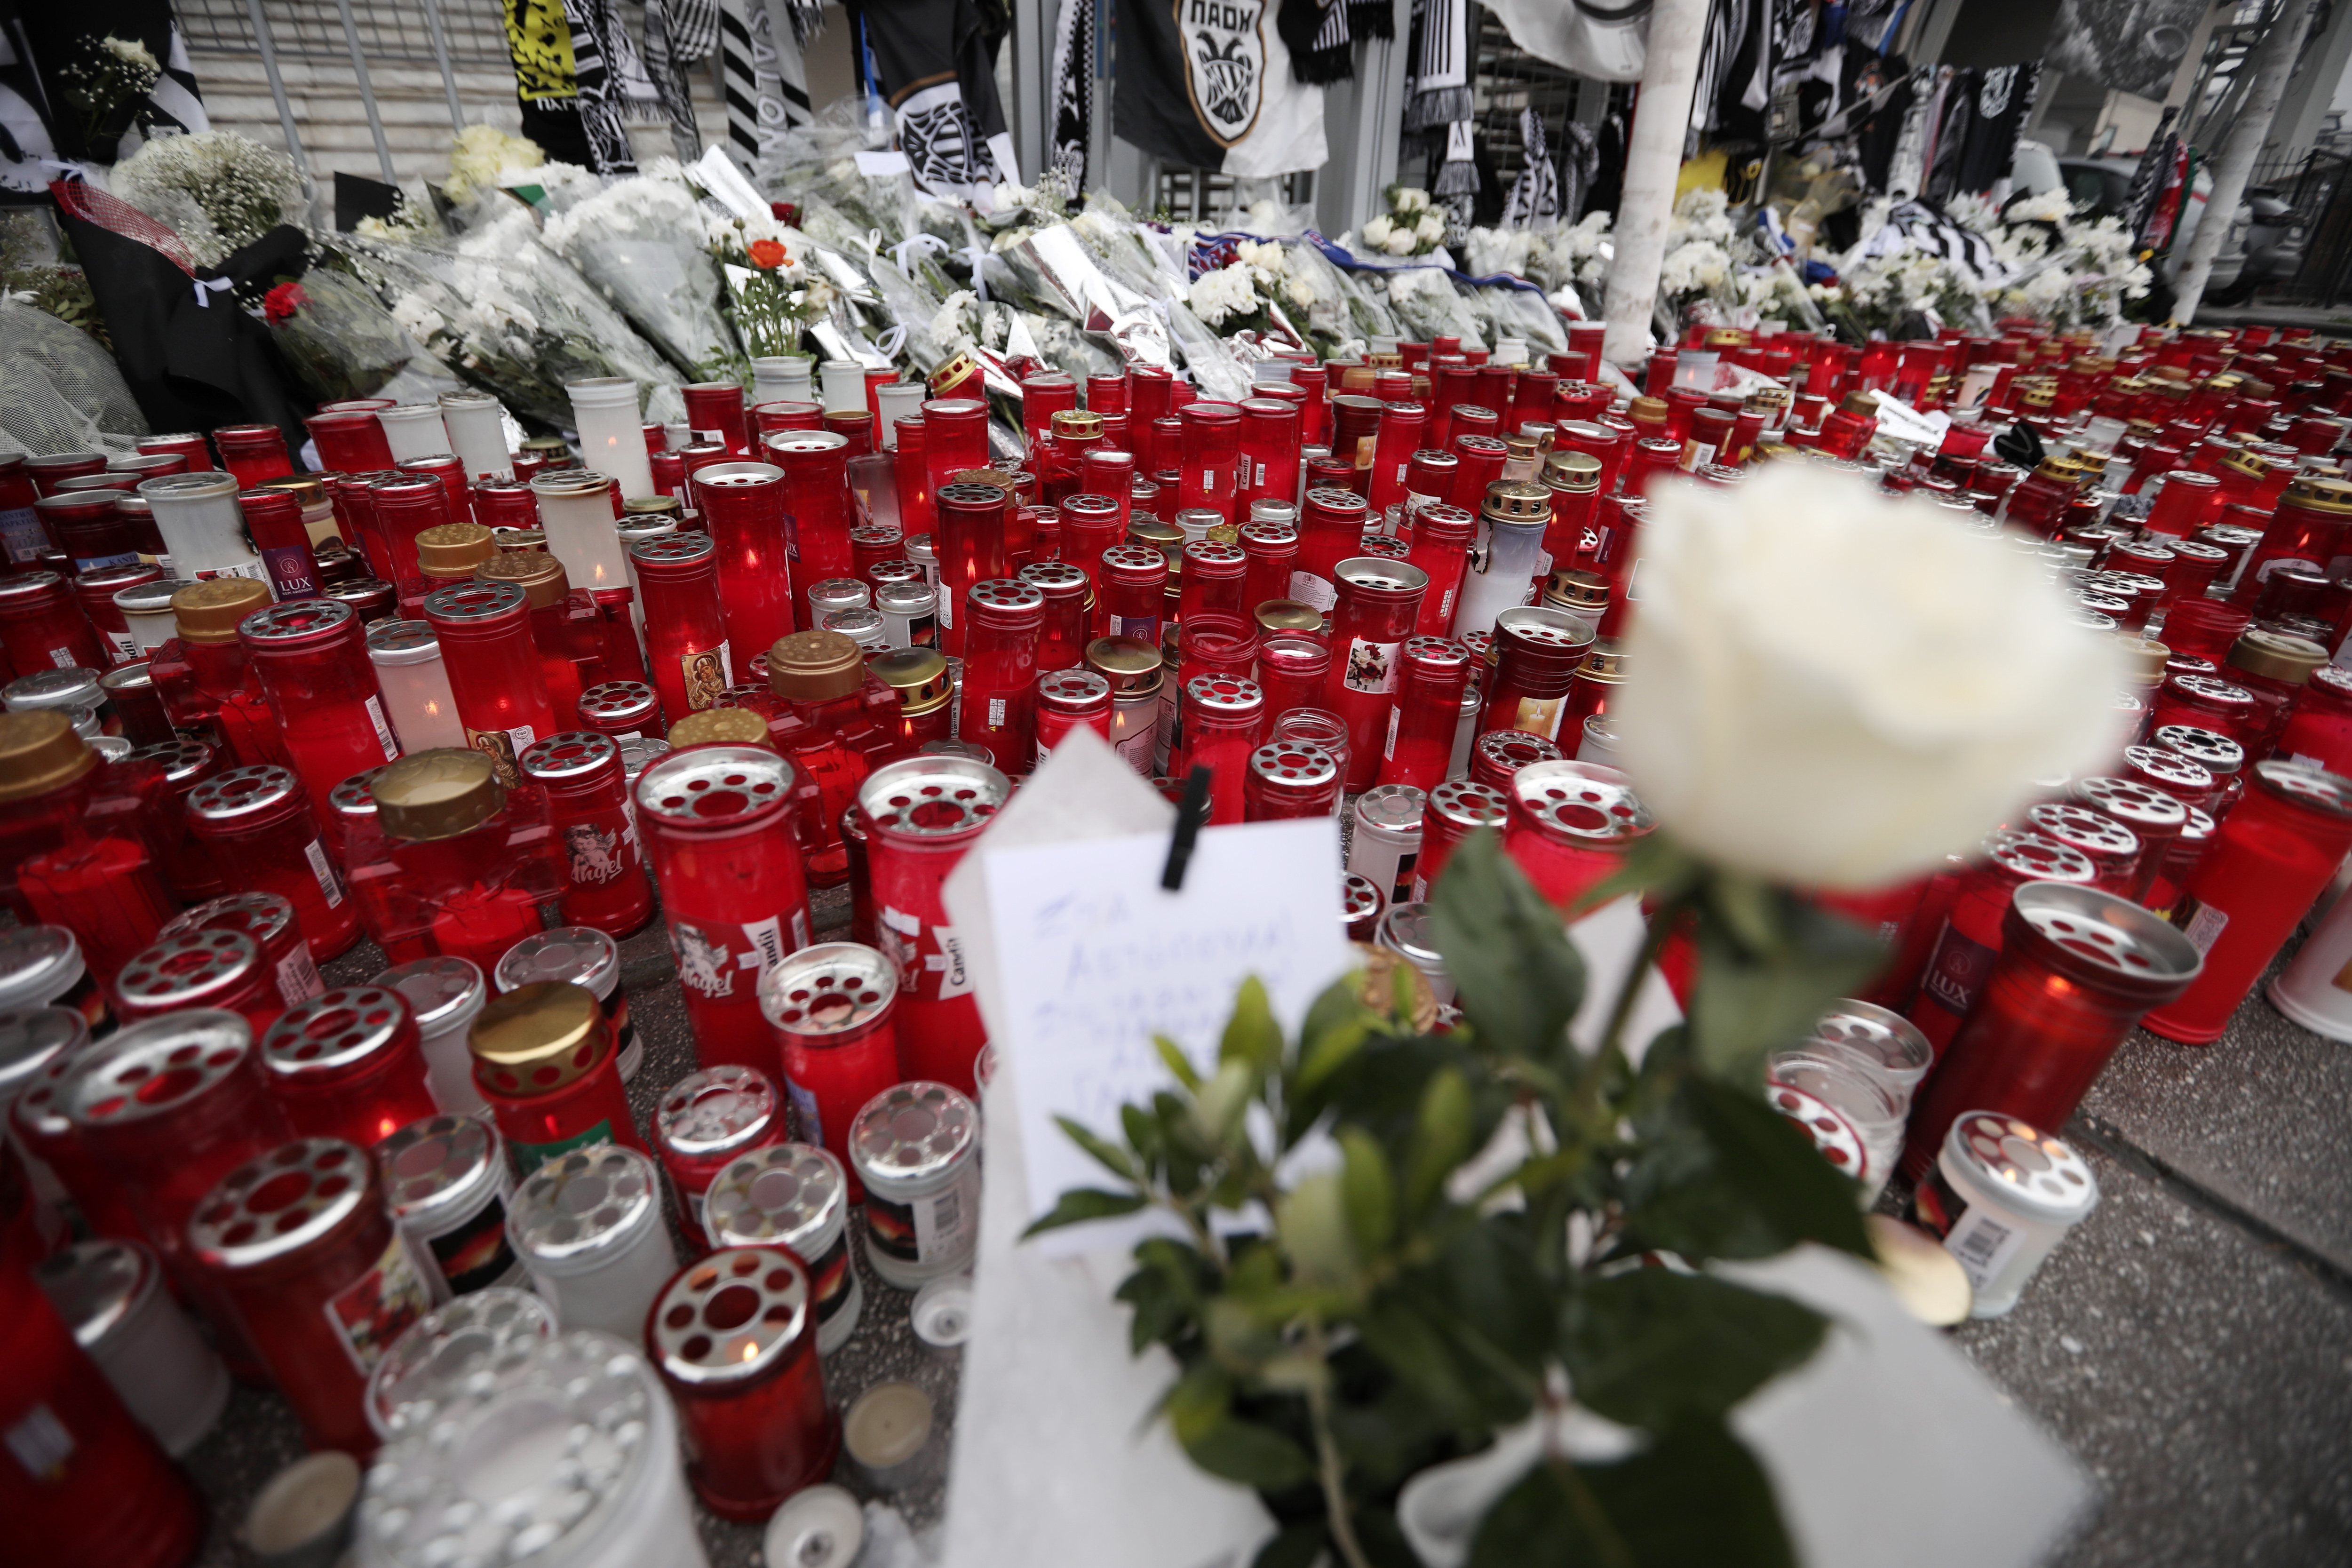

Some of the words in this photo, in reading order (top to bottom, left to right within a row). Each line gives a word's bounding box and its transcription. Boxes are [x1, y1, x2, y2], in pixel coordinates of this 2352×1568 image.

[1191, 0, 1254, 33] ΠΑΟΚ
[278, 576, 312, 591] LUX
[571, 849, 624, 884] Angel
